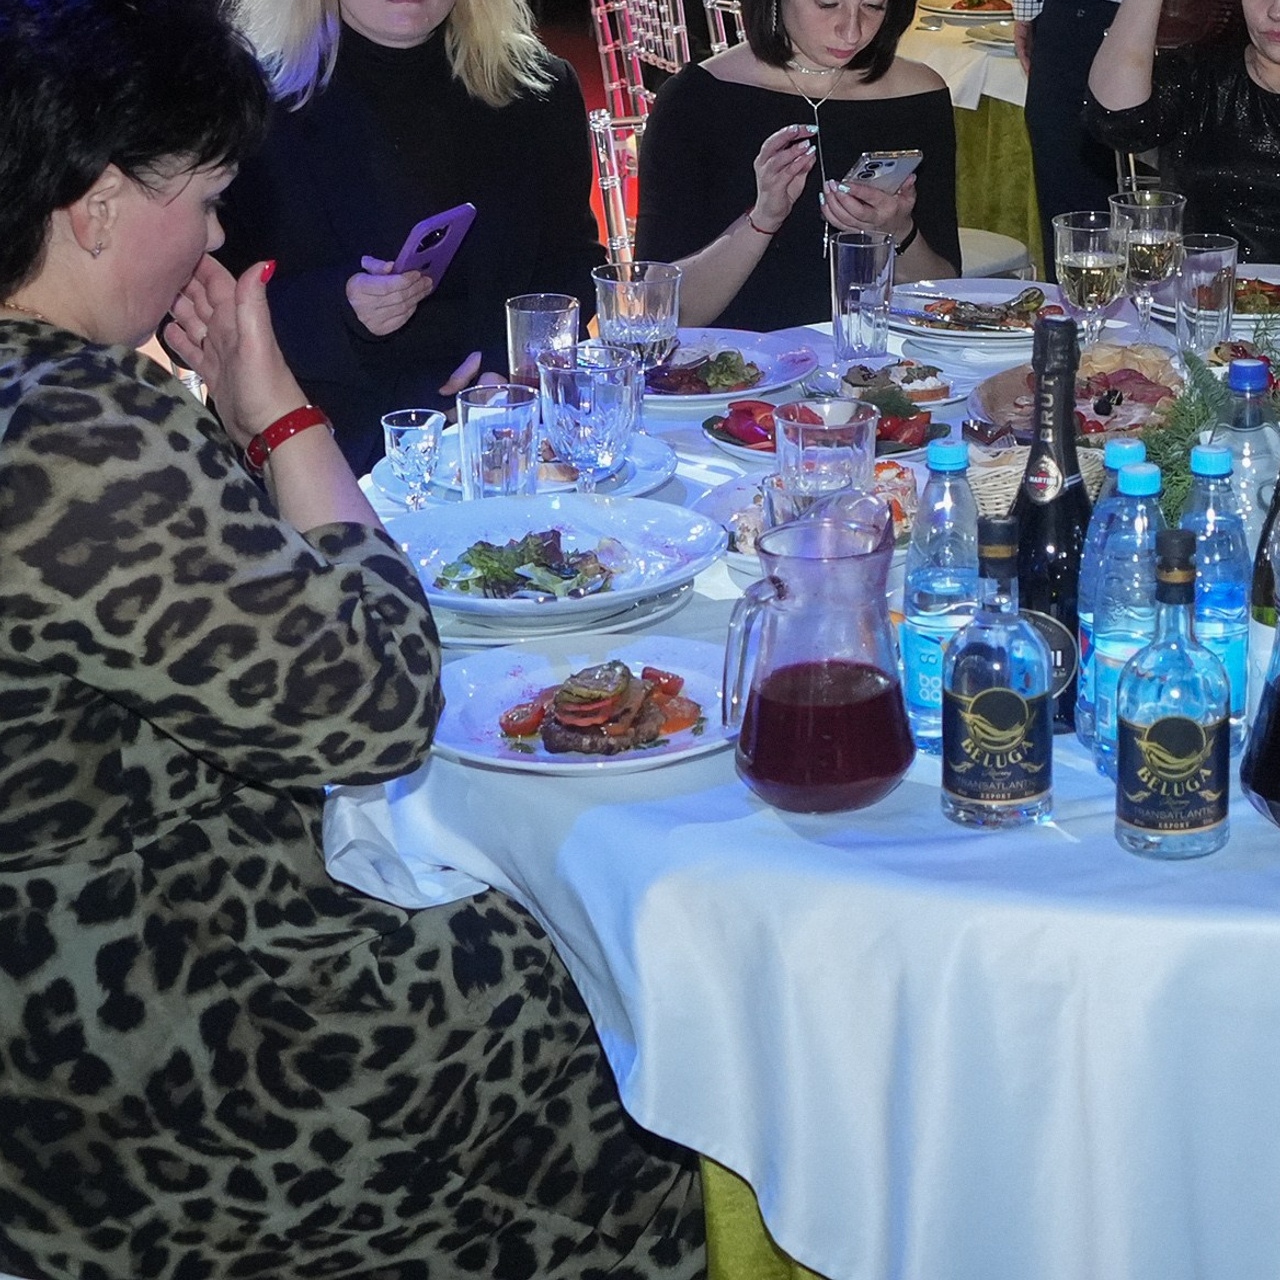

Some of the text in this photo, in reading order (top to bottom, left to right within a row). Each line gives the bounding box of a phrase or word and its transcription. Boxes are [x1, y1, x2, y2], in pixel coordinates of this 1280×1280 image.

[1040, 374, 1057, 442] BRUT
[961, 738, 1034, 768] BELUGA
[1136, 766, 1212, 797] BELUGA
